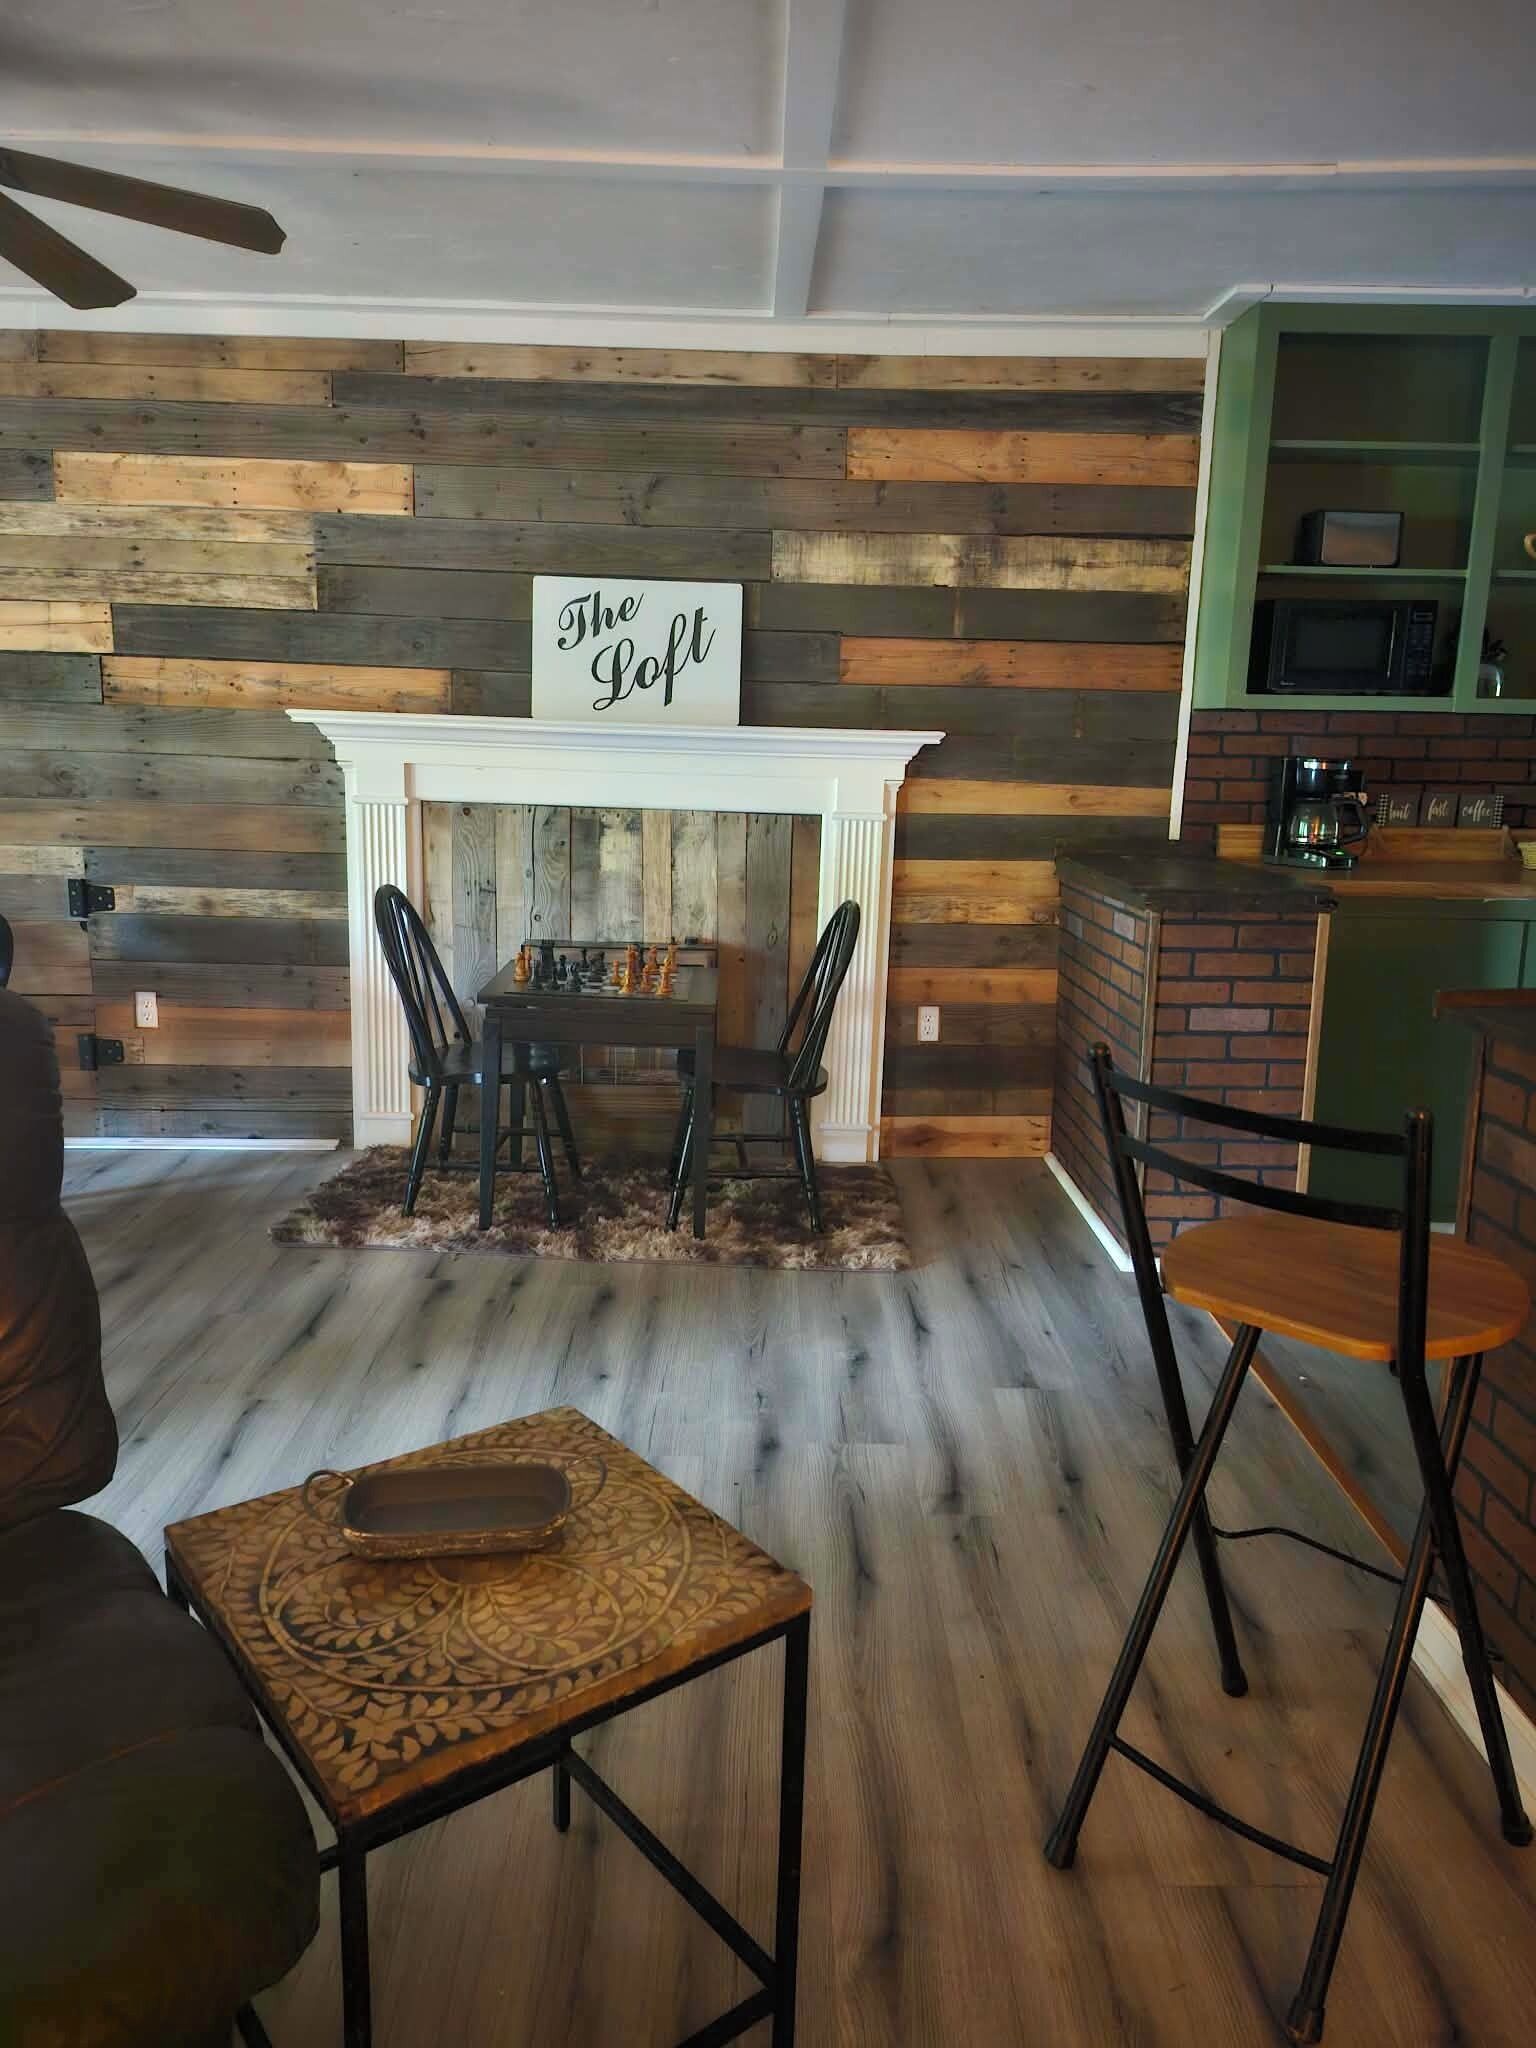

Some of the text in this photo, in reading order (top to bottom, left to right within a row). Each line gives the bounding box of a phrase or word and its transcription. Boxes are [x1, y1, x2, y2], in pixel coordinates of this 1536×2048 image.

[557, 590, 644, 649] The
[591, 607, 716, 711] Loft
[1462, 799, 1491, 822] coffee
